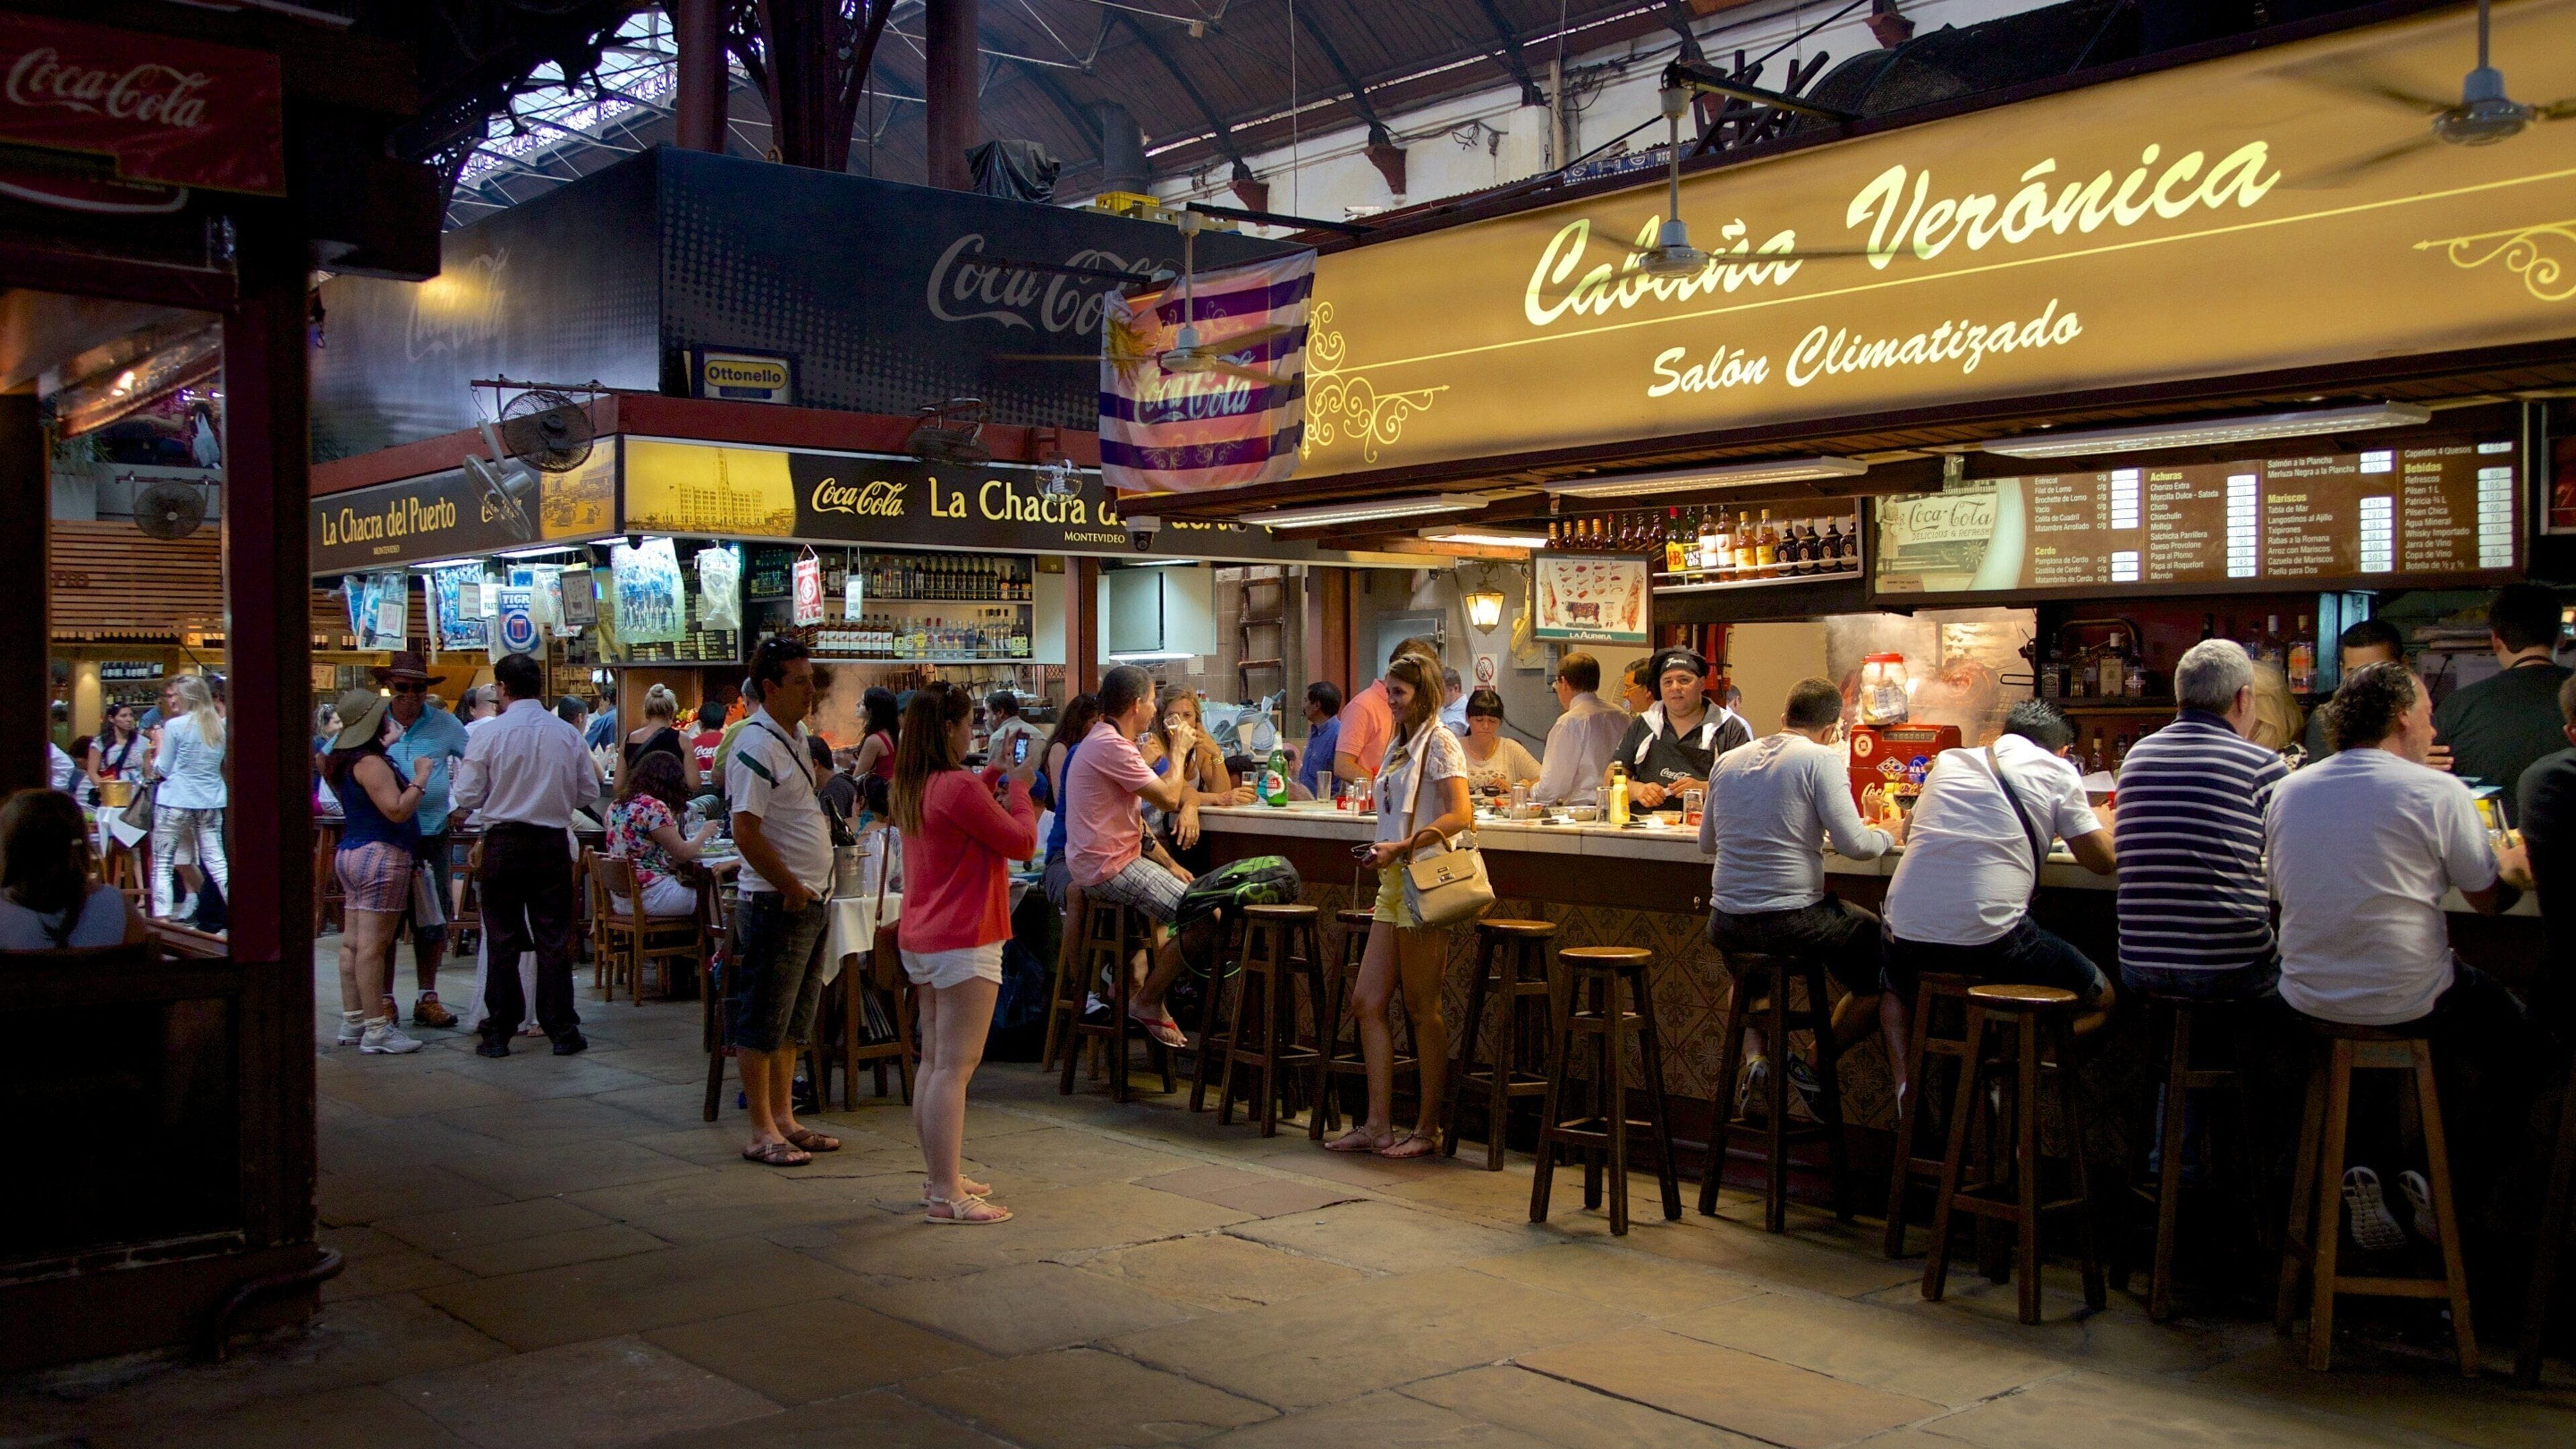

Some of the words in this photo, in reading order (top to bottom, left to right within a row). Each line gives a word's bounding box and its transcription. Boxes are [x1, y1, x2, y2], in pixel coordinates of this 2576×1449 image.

[1524, 215, 1805, 326] Cabaña
[1846, 141, 2280, 270] Verónica
[1648, 343, 1770, 396] Salón
[1785, 298, 2082, 387] Climatizado
[708, 366, 782, 382] Ottonello
[2438, 447, 2443, 455] 4
[2445, 445, 2473, 455] Quesos
[2267, 460, 2292, 468] Salmón
[2306, 456, 2333, 465] Plancha
[2267, 470, 2293, 479] Merluza
[2294, 468, 2314, 478] Negra
[2328, 466, 2356, 474] Plancha
[2404, 462, 2443, 473] Bebidas
[2035, 477, 2058, 485] Entrecot
[2150, 472, 2182, 482] Achuras
[2405, 475, 2440, 484] Refrescos
[2150, 483, 2174, 491] Chorizo
[2405, 486, 2426, 495] Pilsen
[928, 476, 967, 519] La
[979, 480, 1087, 525] Chacra
[2035, 496, 2061, 504] Brochette
[2150, 493, 2174, 501] Morcilla
[2176, 492, 2193, 500] Dulce
[2198, 490, 2218, 498] Salada
[2267, 494, 2307, 504] Mariscos
[2405, 497, 2432, 506] Patricia
[2441, 496, 2447, 504] L
[2150, 503, 2168, 511] Choto
[2268, 505, 2285, 514] Tabla
[2296, 504, 2309, 513] Mar
[2405, 508, 2426, 517] Pilsen
[2428, 506, 2448, 515] Chica
[322, 512, 337, 546] La
[339, 507, 383, 544] Chacra
[386, 498, 407, 537] del
[409, 496, 456, 533] Puerto
[1909, 500, 1993, 532] Coca-Cola
[2059, 513, 2080, 521] Cuadril
[2150, 512, 2182, 521] Chinchulín
[2268, 516, 2307, 526] Langostinos
[2316, 513, 2333, 523] Ajillo
[2367, 511, 2383, 519] 790
[2405, 519, 2423, 529] Agua
[2424, 517, 2452, 526] Mineral
[2490, 514, 2501, 522] 70
[2035, 524, 2063, 532] Matambre
[2063, 523, 2089, 531] Arrollado
[2151, 523, 2172, 531] Molleja
[2268, 526, 2302, 535] Txipirones
[2367, 521, 2382, 529] 385
[1063, 530, 1126, 545] MONTEVIDEO
[1911, 530, 1948, 541] DELICIOUS
[2151, 532, 2179, 541] Salchicha
[2180, 531, 2208, 539] Parrillera
[2405, 529, 2432, 539] Whisky
[2432, 527, 2470, 537] Importado
[2268, 536, 2288, 545] Rabas
[2302, 535, 2330, 543] Romana
[2367, 532, 2382, 540] 385
[2151, 543, 2169, 551] Queso
[2171, 541, 2201, 549] Provolone
[2268, 547, 2285, 555] Arroz
[2300, 545, 2330, 553] Mariscos
[2367, 542, 2382, 550] 505
[2405, 540, 2423, 549] Jarra
[2424, 539, 2434, 547] de
[2435, 539, 2453, 547] Vino
[2035, 546, 2057, 555] Cerdo
[2405, 551, 2424, 560] Copa
[2424, 550, 2434, 558] de
[2436, 549, 2453, 557] Vino
[2035, 557, 2063, 566] Pamplona
[2151, 553, 2165, 561] Papa
[2268, 557, 2292, 566] Cazuela
[2294, 556, 2302, 564] de
[2303, 555, 2334, 564] Mariscos
[2367, 552, 2382, 561] 505
[2151, 562, 2165, 571] Papa
[2166, 561, 2172, 570] al
[2174, 561, 2204, 570] Roquefort
[2235, 558, 2249, 566] 145
[2406, 561, 2430, 570] Botella
[2430, 561, 2440, 570] de
[2450, 562, 2455, 570] y
[2487, 558, 2503, 566] 230
[2035, 567, 2055, 575] Costilla
[2151, 572, 2174, 580] Morrón
[2235, 568, 2249, 576] 130
[2268, 567, 2288, 576] Paella
[2288, 568, 2303, 576] para
[2304, 566, 2318, 574] Dos
[2035, 576, 2067, 584] Matambrito
[502, 594, 531, 604] TIGR
